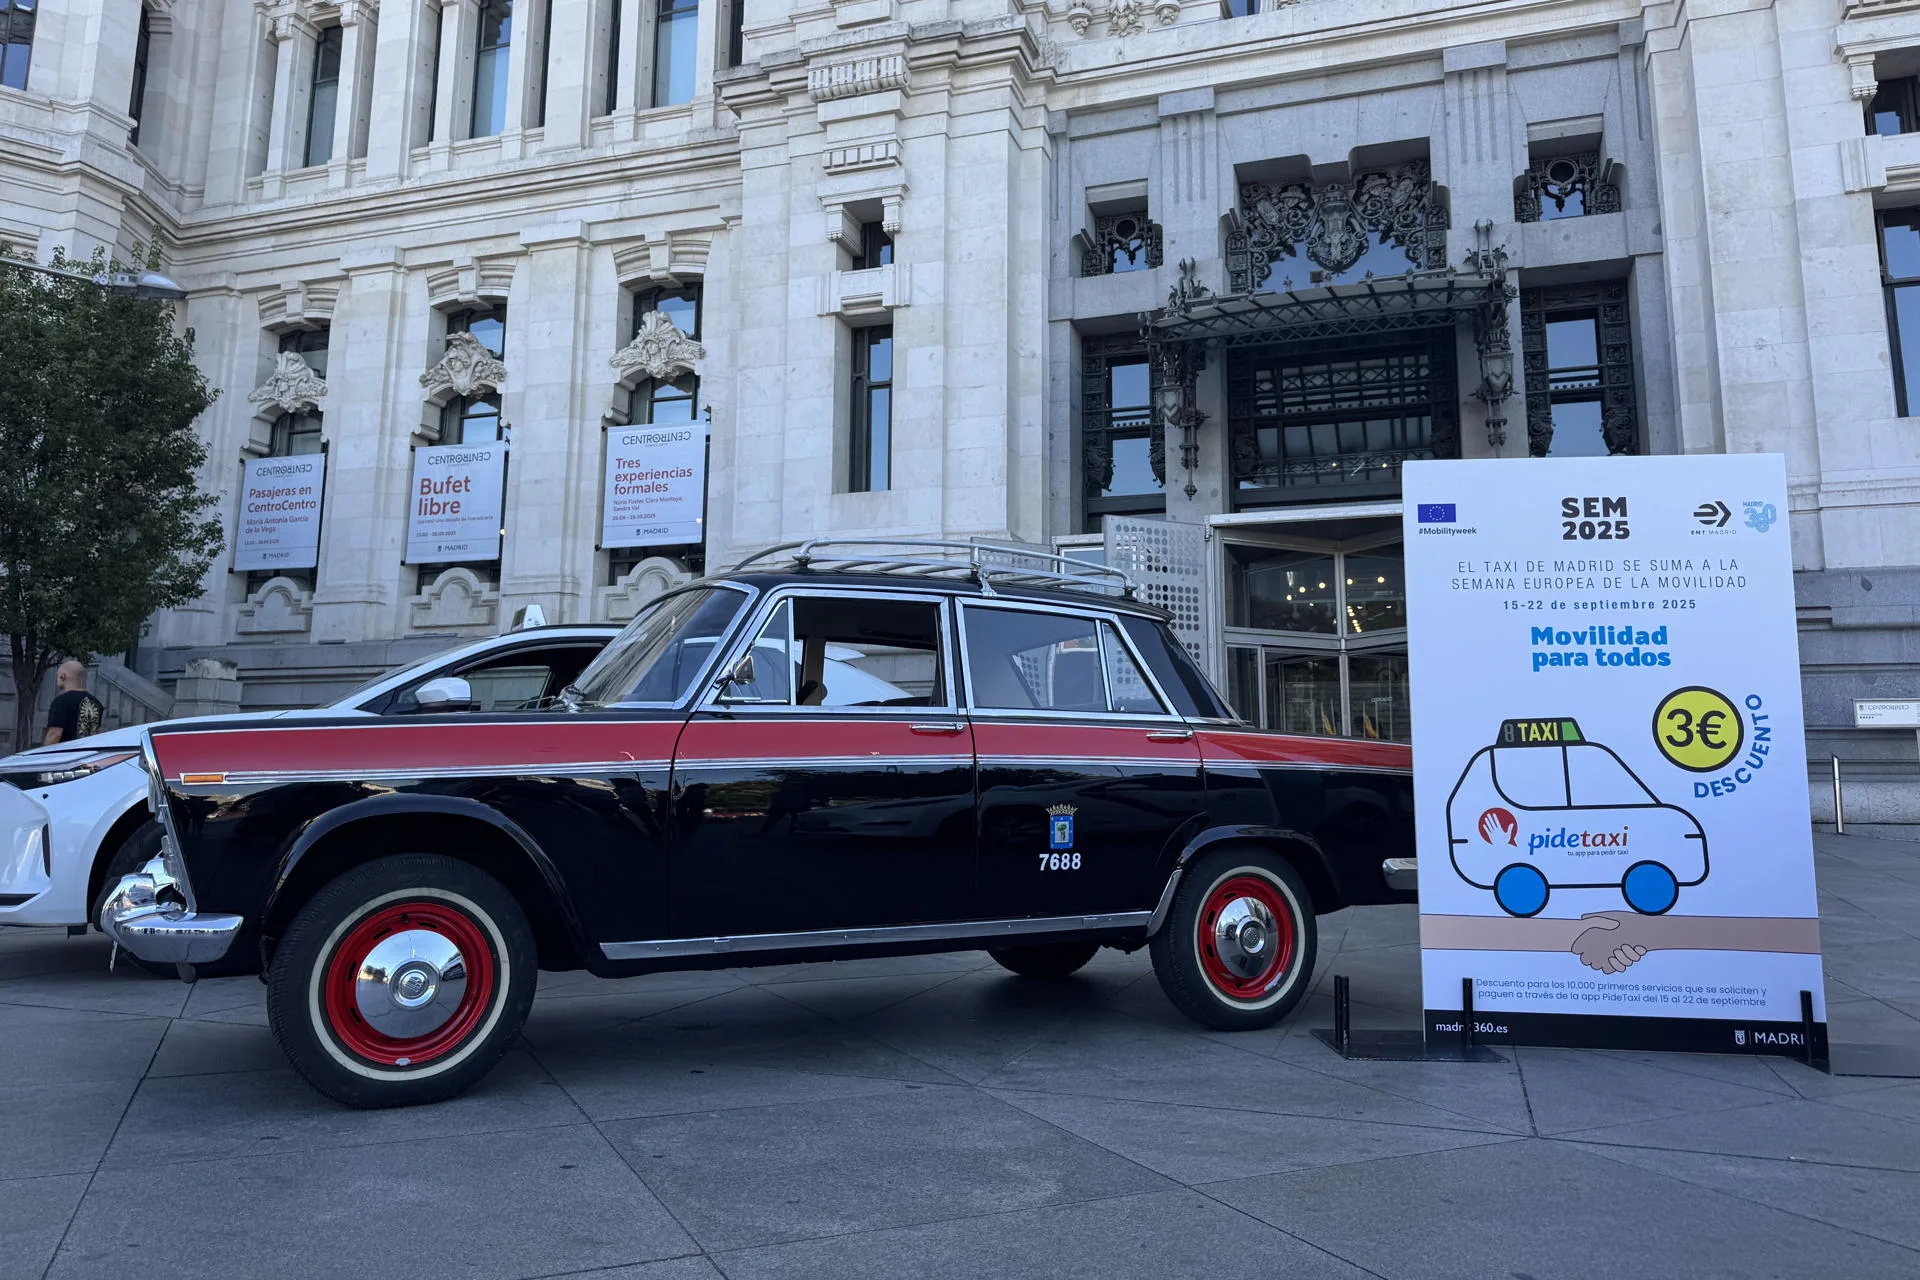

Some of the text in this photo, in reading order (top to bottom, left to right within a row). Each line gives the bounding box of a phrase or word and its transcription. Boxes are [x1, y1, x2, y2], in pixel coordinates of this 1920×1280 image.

[615, 458, 641, 470] Tres
[614, 467, 693, 485] experiencias
[249, 486, 312, 499] Pasajeras en
[420, 475, 471, 495] Bufet
[614, 482, 669, 496] formales
[247, 500, 317, 514] CentroCentro
[418, 497, 461, 516] libre
[1561, 496, 1628, 518] SEM
[643, 527, 669, 535] MADRID
[1418, 526, 1478, 537] #Mobilityweek
[1562, 520, 1631, 541] 2025
[268, 551, 290, 559] MADRID
[444, 544, 468, 552] MADRID
[1458, 558, 1739, 573] EL TAXI DE MADRID SE SUMA A LA
[1451, 575, 1747, 590] SEMANA EUROPEA DE LA MOVILIDAD
[1503, 599, 1697, 611] 15-22 de septiembre 2025
[1530, 625, 1669, 646] Movilidad
[1531, 646, 1672, 673] para todos
[1517, 721, 1559, 742] TAXI
[1665, 708, 1728, 750] 3€
[1693, 693, 1772, 799] DESCUENTO
[1528, 825, 1629, 856] pidetaxi
[1601, 849, 1616, 857] pedir
[1039, 852, 1082, 871] 7688
[1476, 978, 1767, 998] Descuento para los 10.000 primeros servicios que se soliciten y
[1478, 990, 1767, 1007] paguen a través de la app PideTaxi del 15 al 22 de septiembre
[1435, 1021, 1508, 1034] madr360.es
[1754, 1031, 1816, 1045] MADRI
